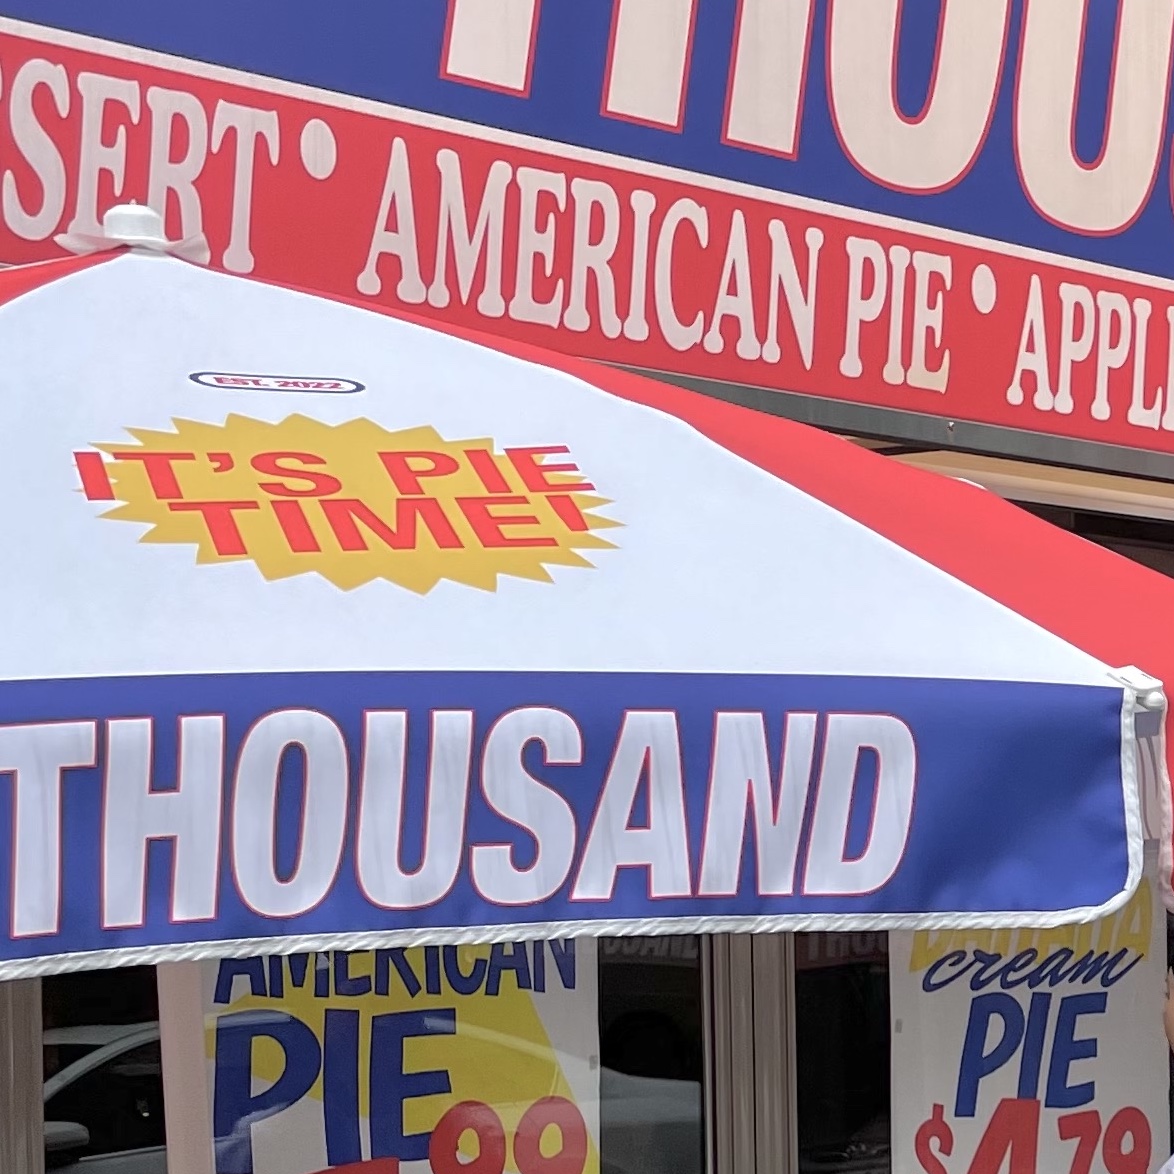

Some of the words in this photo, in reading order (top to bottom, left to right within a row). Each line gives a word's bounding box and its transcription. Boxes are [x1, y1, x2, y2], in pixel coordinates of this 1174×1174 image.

[0, 58, 280, 275] SERT
[356, 136, 824, 372] AMERICAN
[838, 235, 954, 396] PIE
[72, 450, 343, 501] IT'S
[377, 444, 598, 496] PIE
[168, 494, 590, 556] TIME!
[0, 707, 918, 939] THOUSAND
[922, 947, 1145, 993] cream
[954, 991, 1108, 1118] PIE
